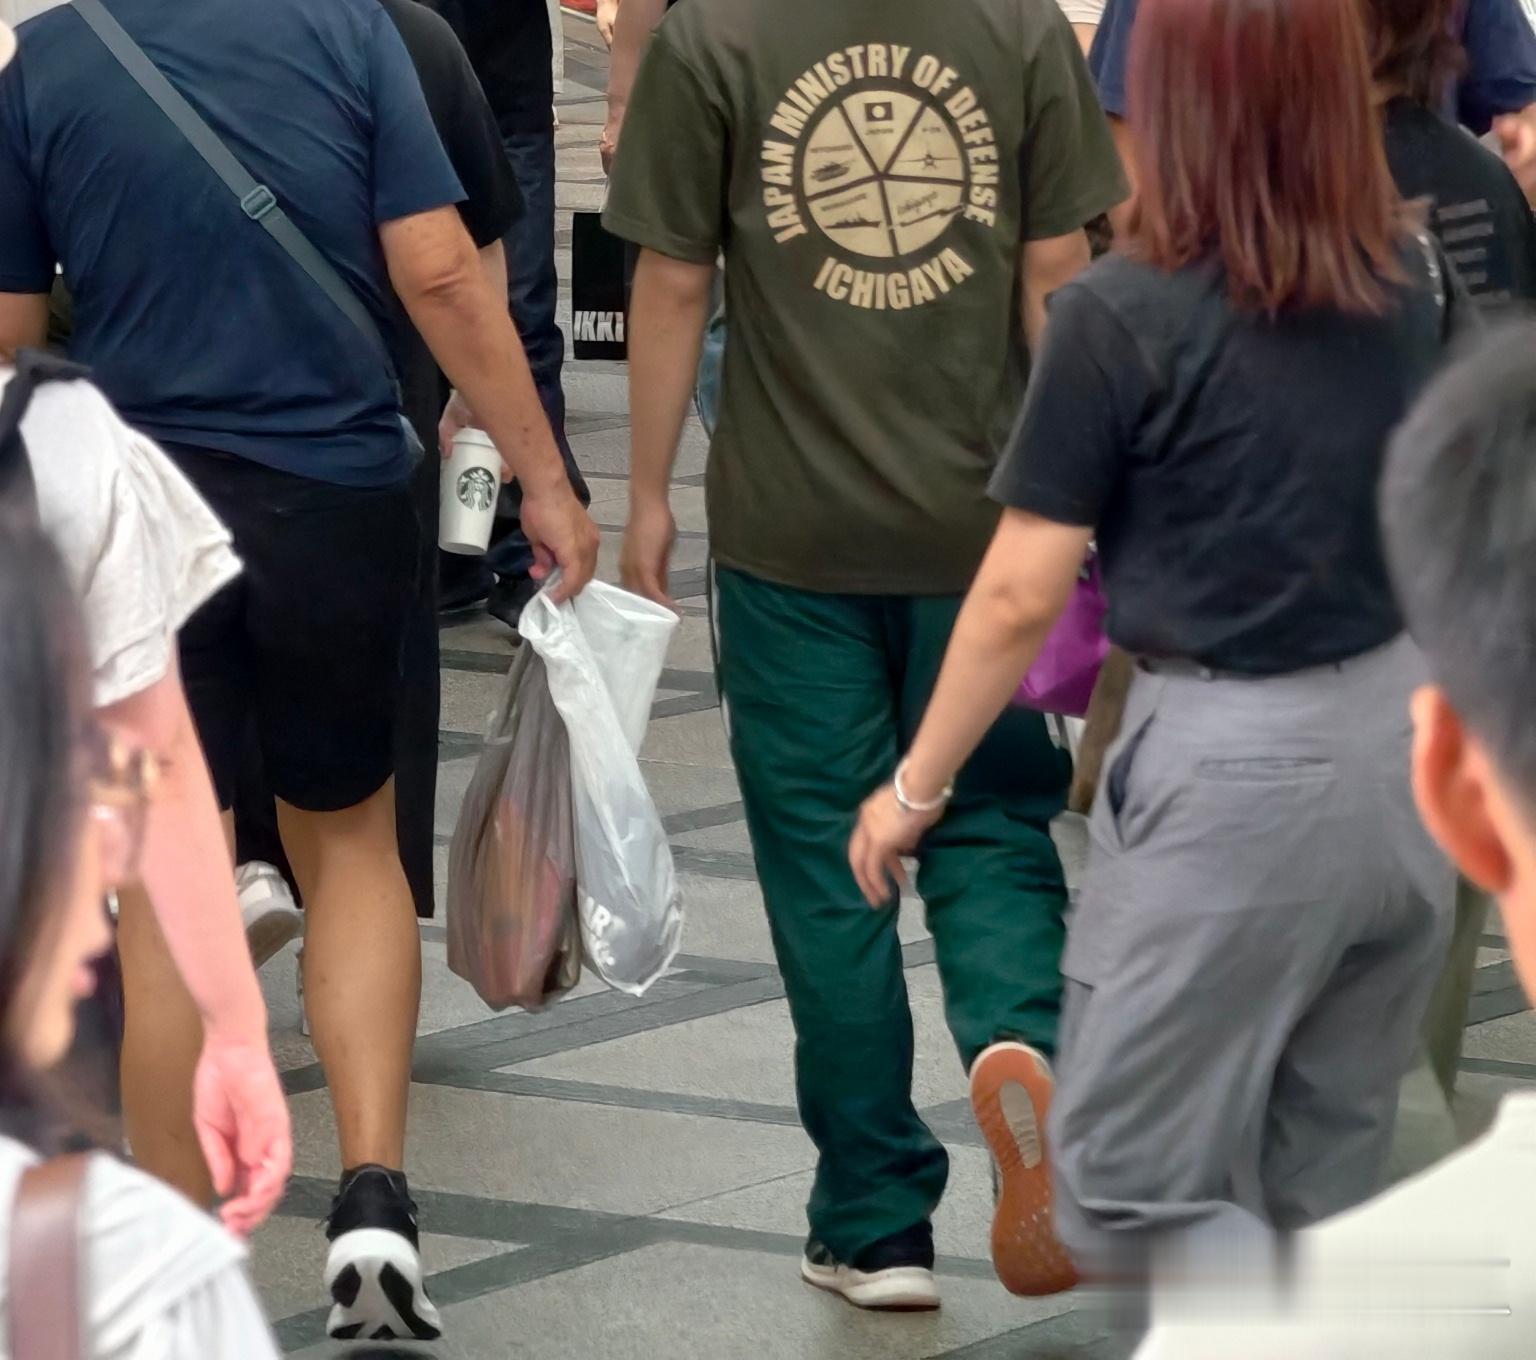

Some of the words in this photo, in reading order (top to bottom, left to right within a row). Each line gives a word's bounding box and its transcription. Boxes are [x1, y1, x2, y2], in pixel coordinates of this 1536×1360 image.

[770, 43, 912, 139] MINISTRY
[911, 54, 959, 96] OF
[760, 140, 808, 244] JAPAN
[944, 86, 1000, 228] DEFENSE
[814, 247, 975, 310] ICHIGAYA
